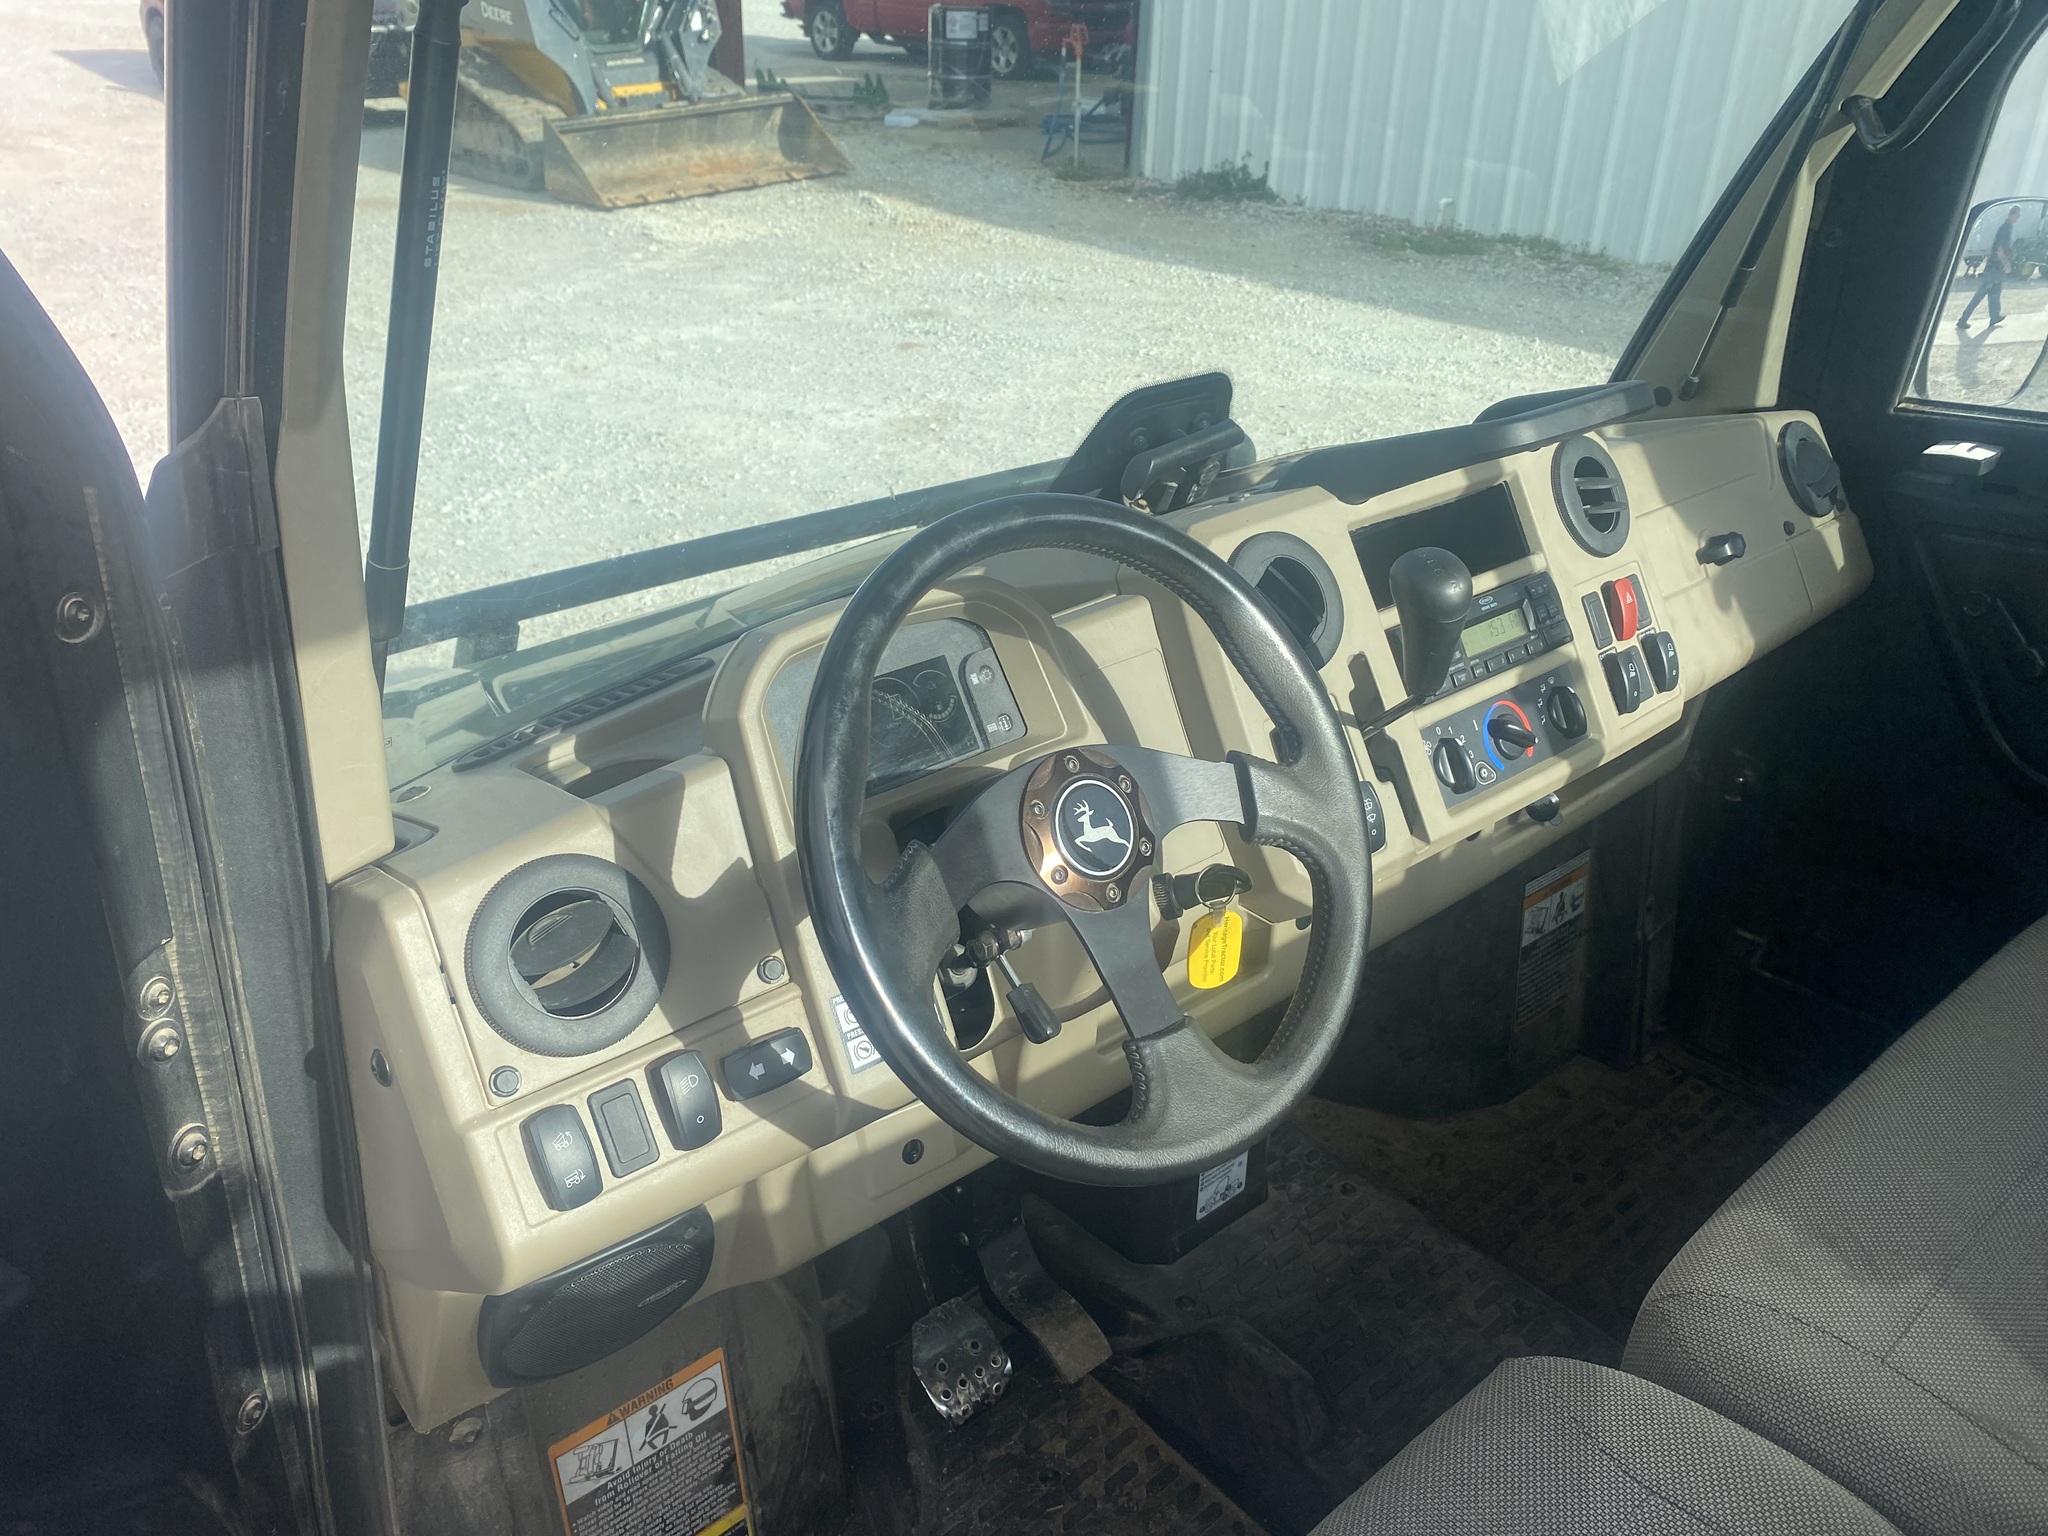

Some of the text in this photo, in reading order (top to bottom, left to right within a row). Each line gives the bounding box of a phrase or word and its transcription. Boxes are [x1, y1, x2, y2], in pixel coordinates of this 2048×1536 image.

[481, 0, 514, 26] DEERE
[424, 176, 441, 268] STABILUS
[1459, 734, 1466, 743] 2
[1468, 750, 1475, 758] 3
[1219, 916, 1230, 982] HeritageTractor.com
[619, 1379, 674, 1417] WARNING
[594, 1430, 708, 1505] from Rollover or Falling Off
[606, 1431, 693, 1490] Avoid Injury or Death
